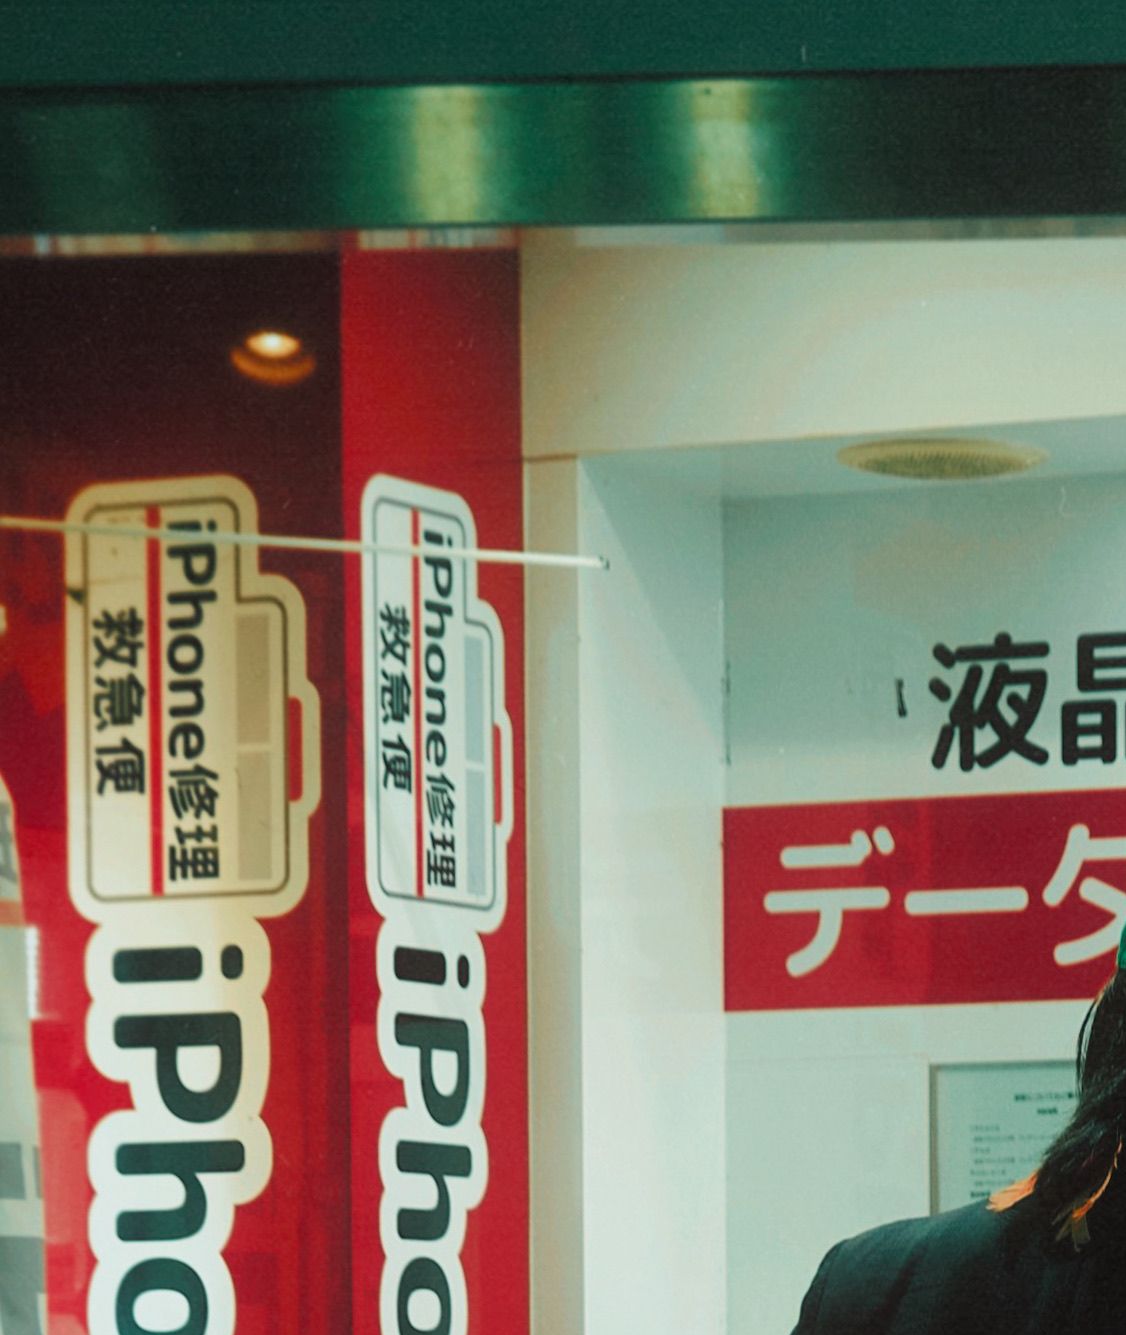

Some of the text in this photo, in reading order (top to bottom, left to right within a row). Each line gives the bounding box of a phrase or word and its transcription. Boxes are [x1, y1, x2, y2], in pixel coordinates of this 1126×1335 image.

[92, 606, 146, 797] 救急便
[378, 603, 414, 795] 救急便
